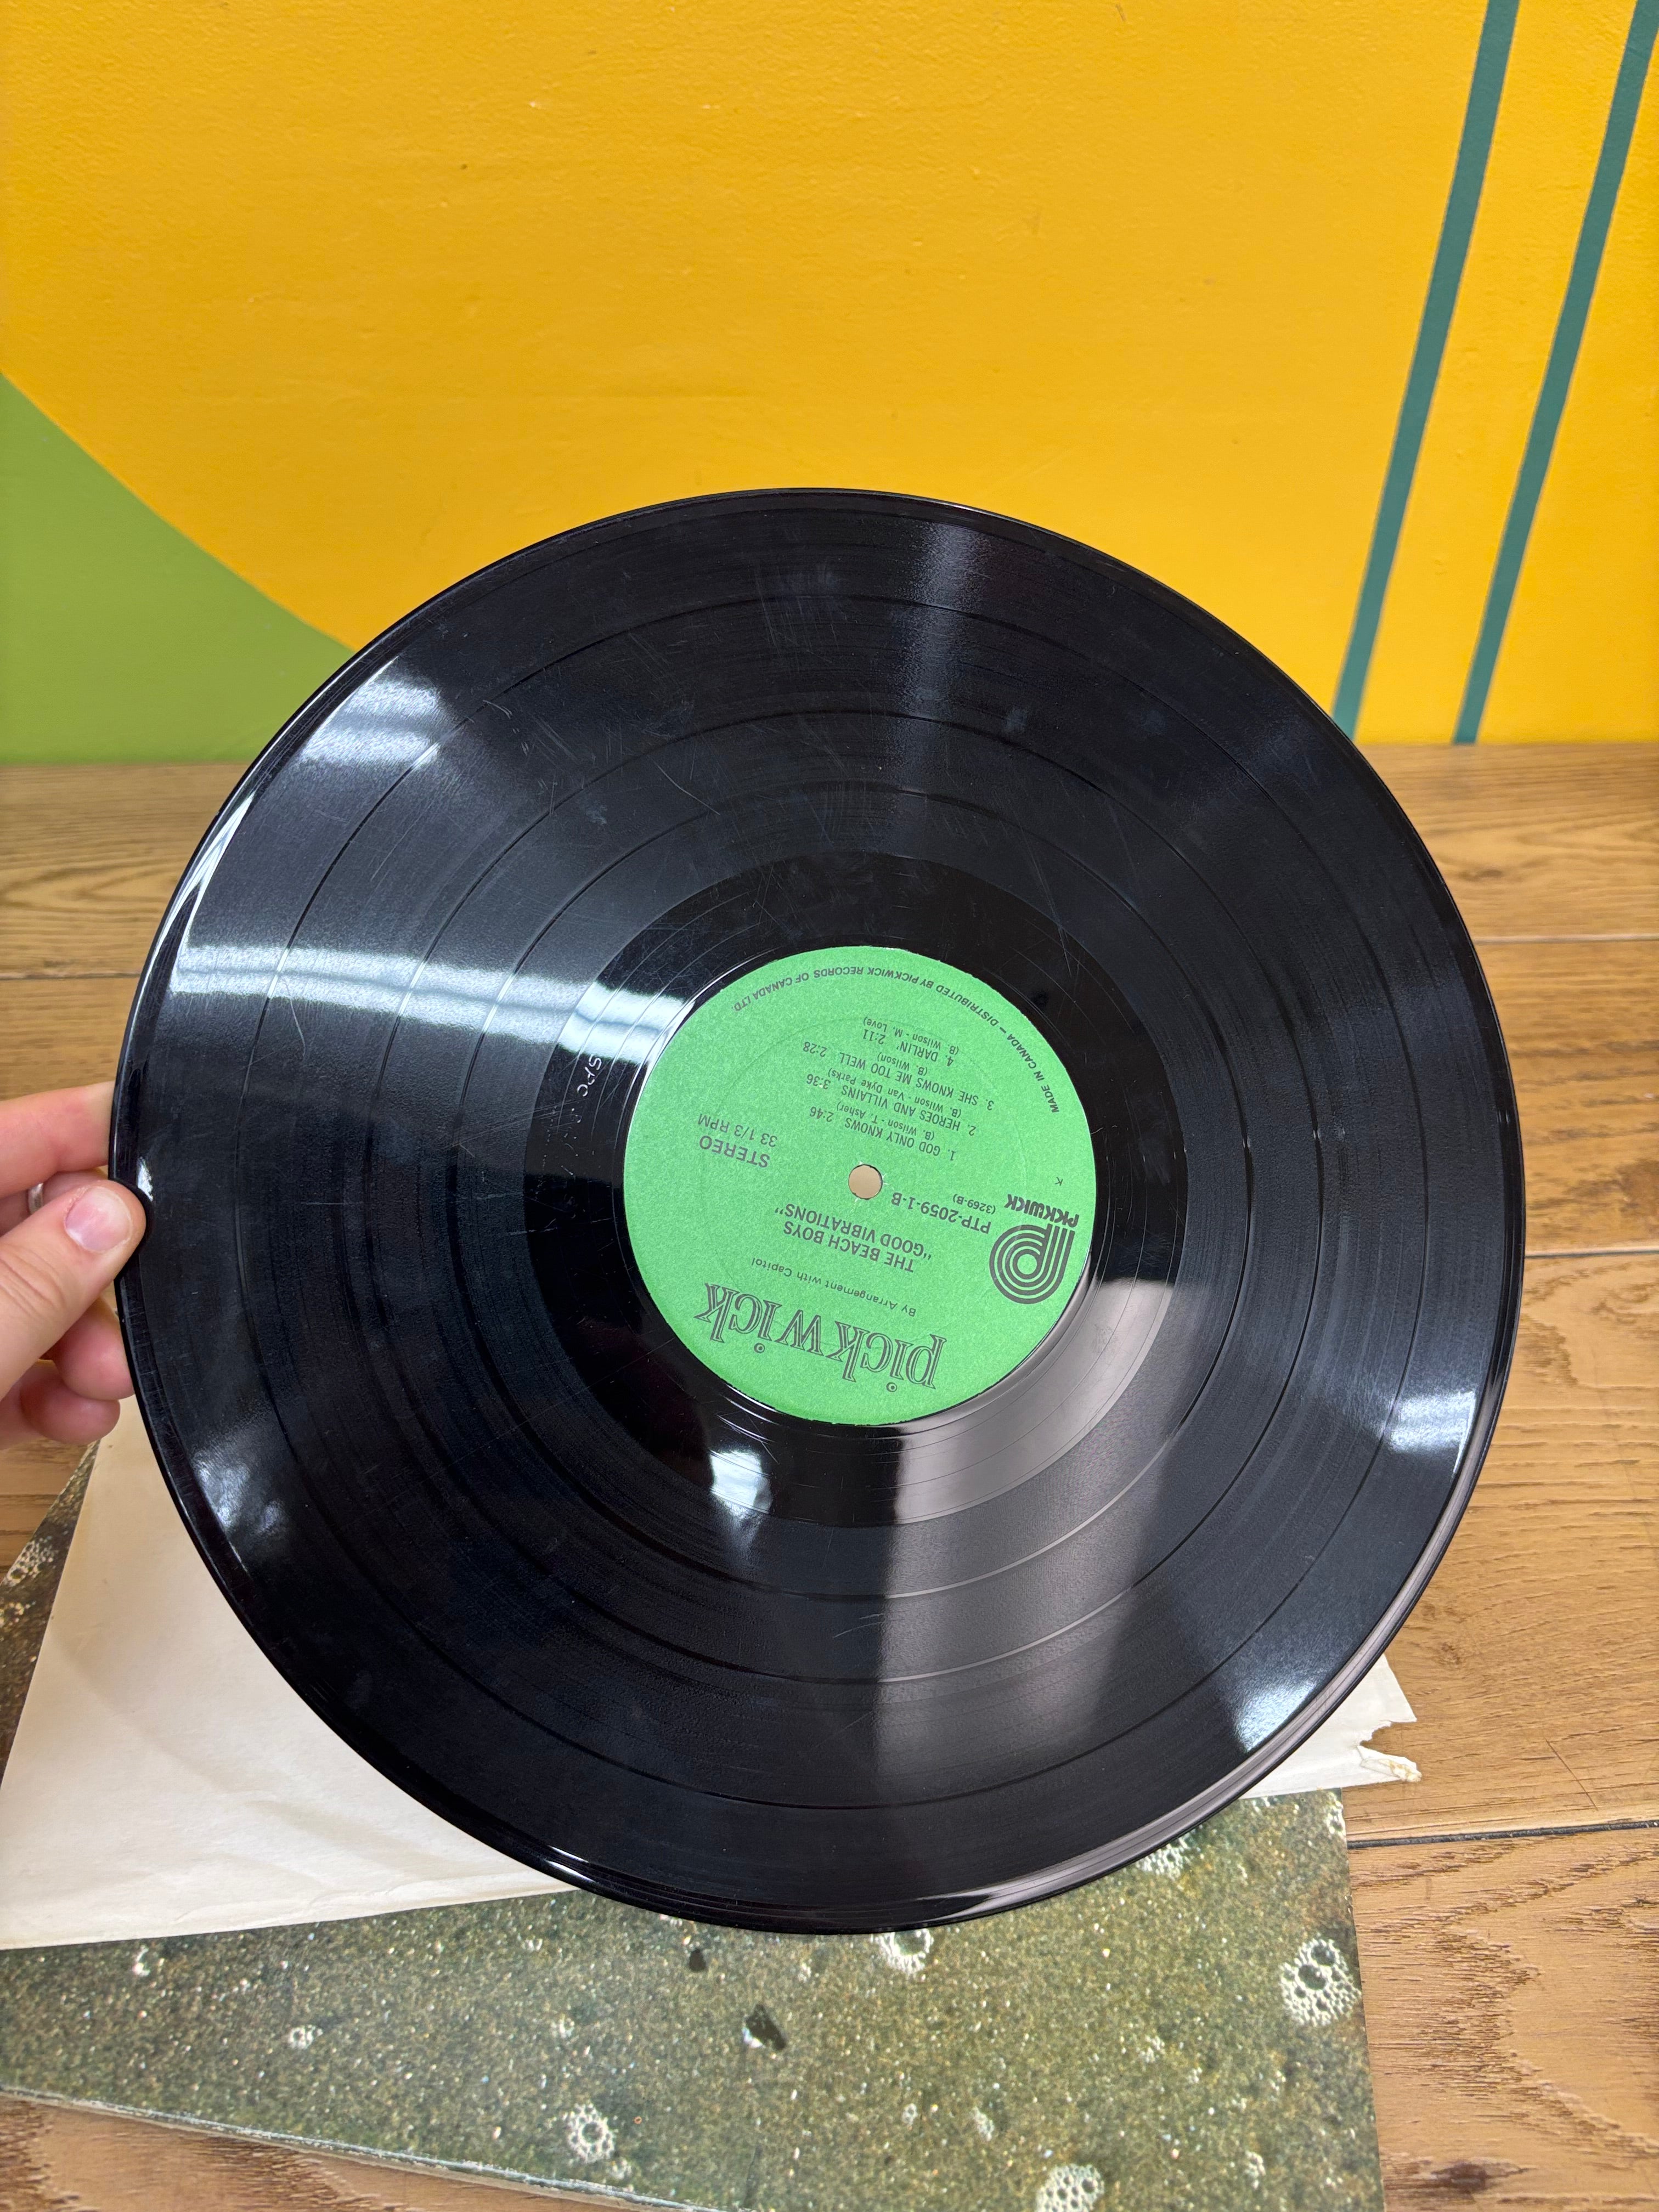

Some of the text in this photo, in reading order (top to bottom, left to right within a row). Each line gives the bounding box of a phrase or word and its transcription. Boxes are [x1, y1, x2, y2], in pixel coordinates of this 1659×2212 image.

[794, 972, 809, 983] OF
[812, 966, 864, 979] RECORDS
[866, 966, 920, 984] PICKWICK
[752, 977, 793, 1000] CANADA
[918, 978, 934, 989] BY
[733, 995, 751, 1012] LTD.
[935, 984, 1000, 1027] DISTRIBUTED
[862, 1015, 888, 1032] Love)
[892, 1026, 903, 1038] M.
[862, 1028, 886, 1045] 2:11
[911, 1033, 941, 1051] Wilson
[948, 1045, 960, 1056] (B.
[1006, 1033, 1037, 1069] CANADA
[876, 1051, 928, 1076] (B. Wilson)
[945, 1054, 954, 1067] 4.
[802, 1041, 995, 1111] 3. SHE KNOWS ME TOO WELL 2:28
[827, 1066, 856, 1085] Parks)
[1032, 1070, 1045, 1082] IN
[860, 1079, 883, 1094] Dyke
[887, 1087, 904, 1101] Van
[805, 1073, 977, 1136] 2. HEROES AND VILLAINS 3:36
[913, 1096, 943, 1113] Wilson
[1040, 1084, 1060, 1113] MADE
[836, 1101, 866, 1119] Asher)
[870, 1113, 878, 1124] T.
[949, 1107, 962, 1119] (B.
[697, 1113, 778, 1148] 33 1/3 RPM
[809, 1105, 956, 1161] 1. GOD ONLY KNOWS 2:46
[887, 1119, 917, 1136] Wilson
[922, 1129, 935, 1141] (B.
[698, 1135, 770, 1168] STEREO
[1054, 1176, 1063, 1187] K
[890, 1191, 992, 1234] PTP-2059-1-B
[952, 1193, 996, 1215] (3269-B)
[1003, 1193, 1080, 1228] PICKWICK
[782, 1220, 914, 1273] THE BEACH BOYS
[751, 1257, 916, 1317] By Arrangement with Capitol
[692, 1282, 947, 1393] pickwick
